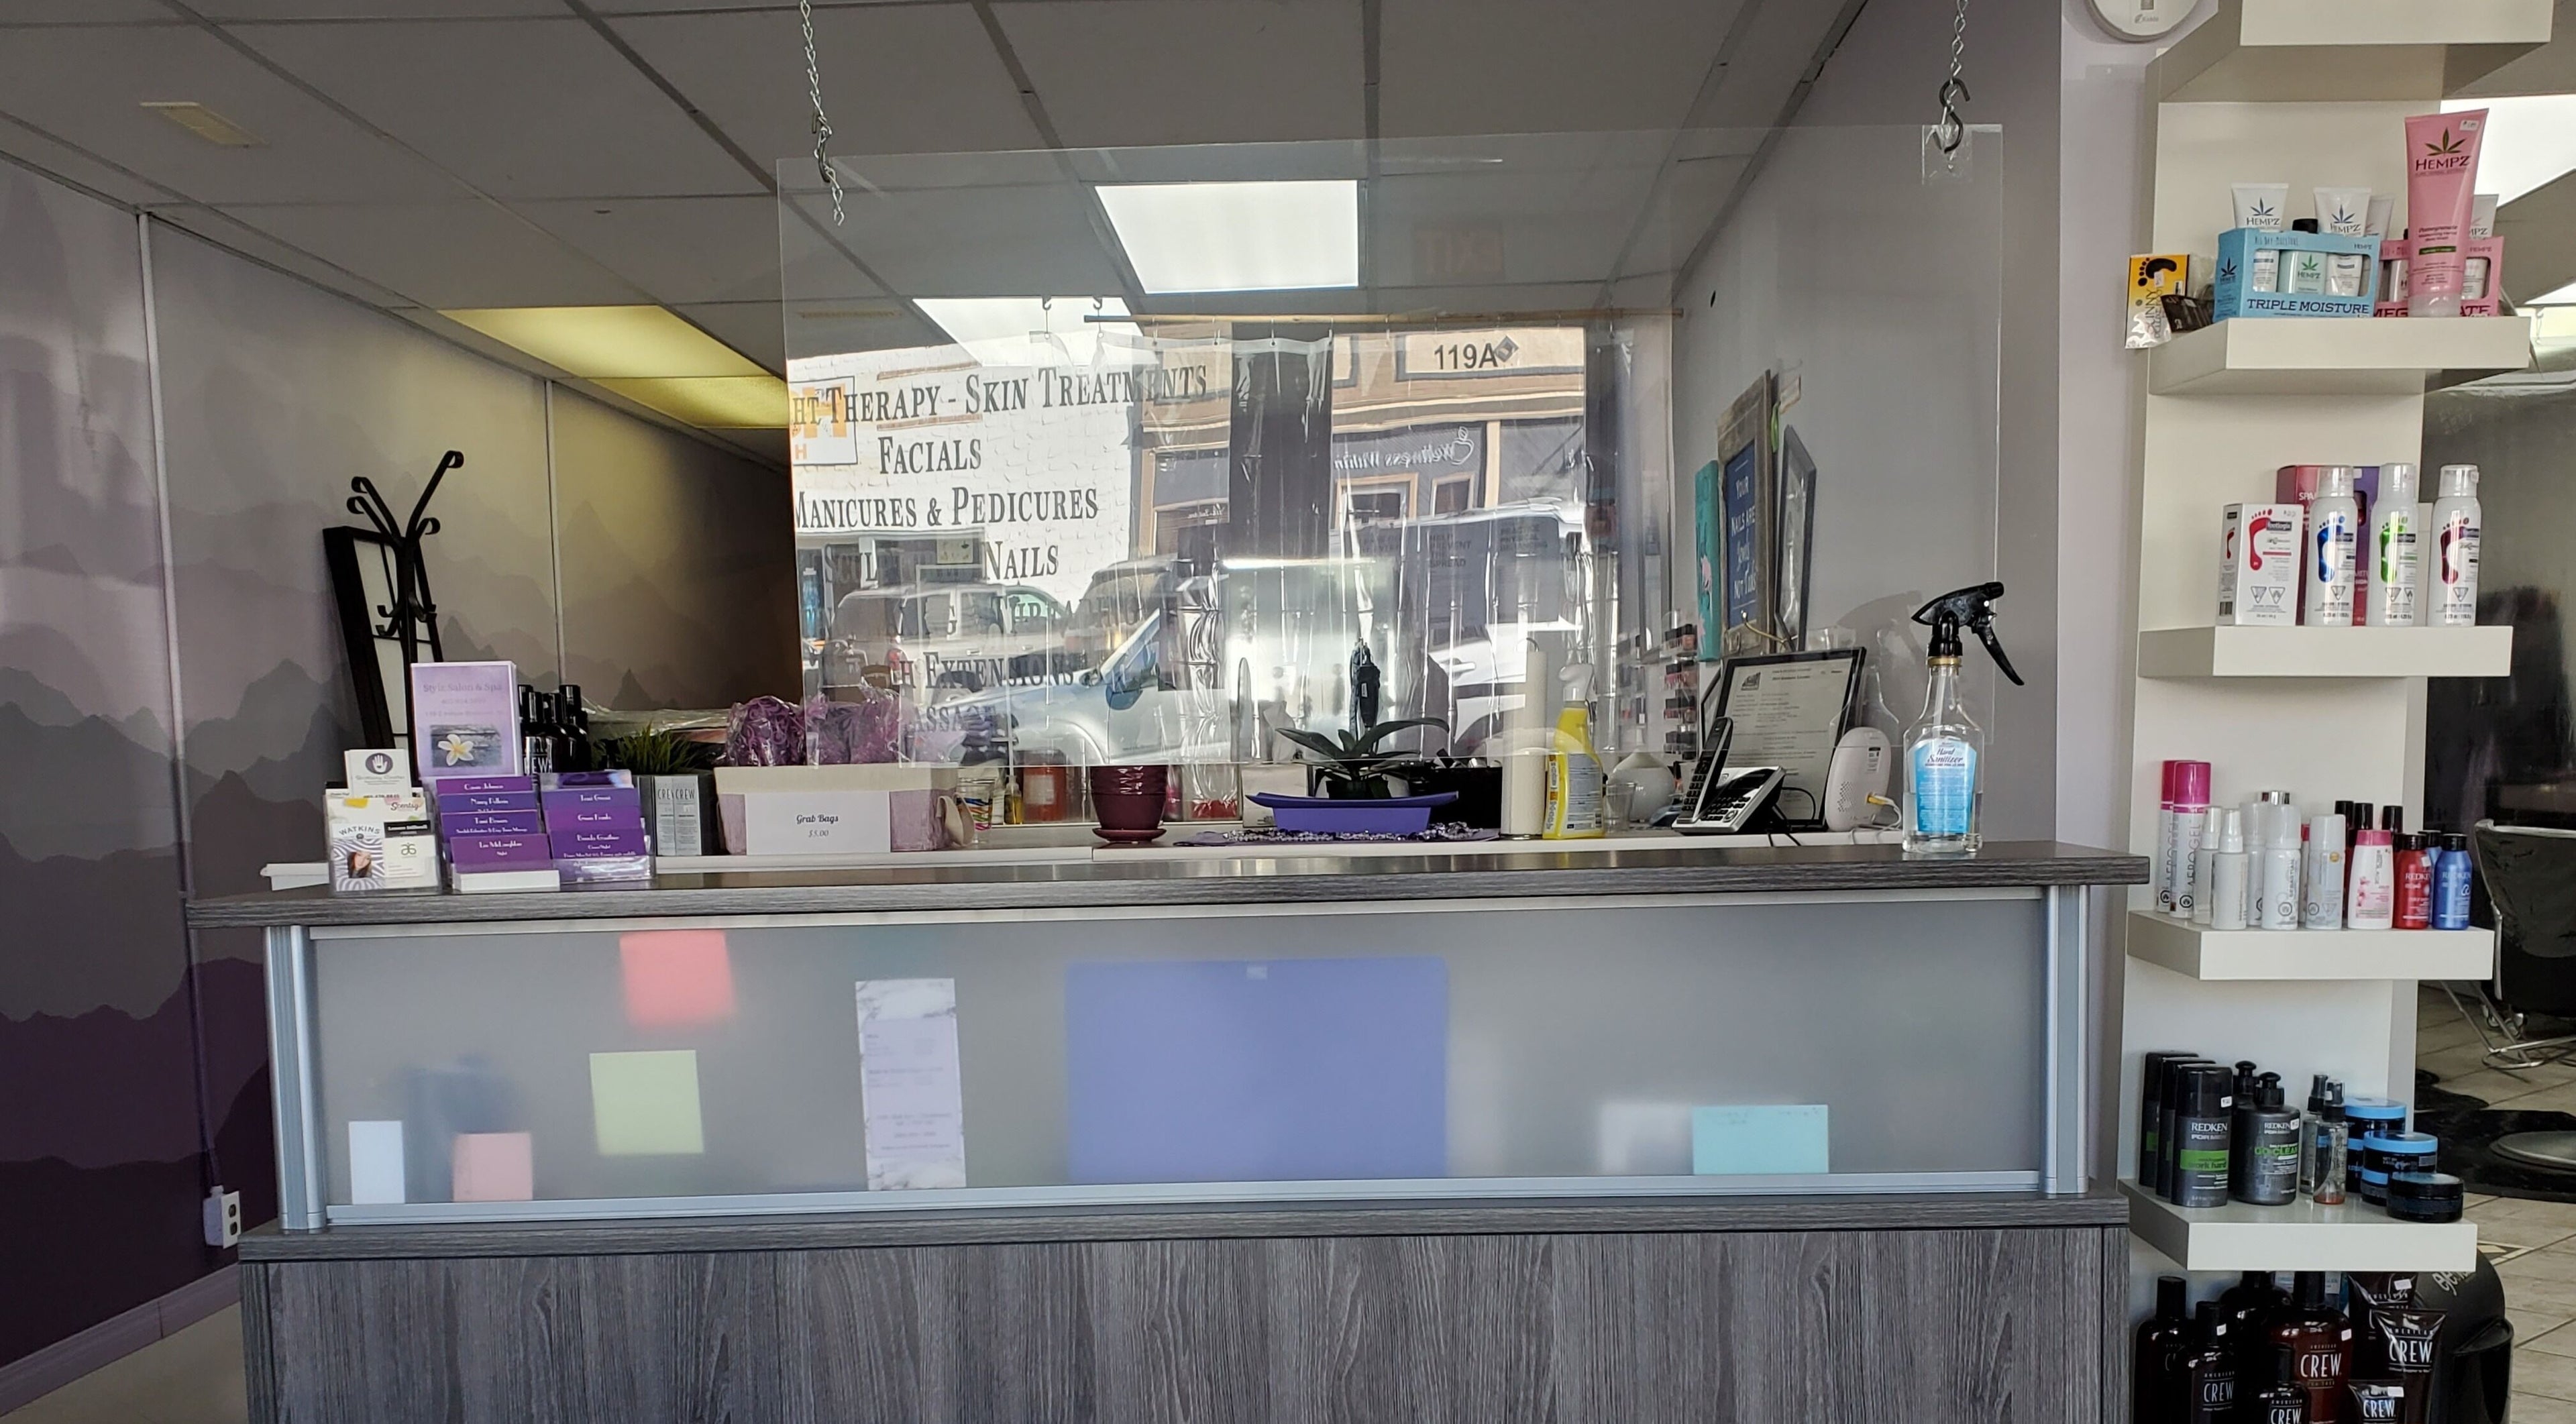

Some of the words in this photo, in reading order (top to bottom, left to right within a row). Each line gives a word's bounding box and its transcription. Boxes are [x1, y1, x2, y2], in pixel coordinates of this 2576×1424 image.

[2416, 156, 2471, 170] HEMPZ
[2247, 217, 2280, 226] HEMPZ
[2330, 223, 2361, 233] HEMPZ
[2298, 271, 2320, 279] HEMPZ
[2247, 299, 2297, 311] TRIPLE
[2299, 301, 2369, 314] MOISTURE
[1434, 342, 1498, 370] 119A
[826, 386, 941, 423] THERAPY
[966, 373, 1028, 414] SKIN
[878, 436, 981, 474] FACIALS
[928, 497, 942, 526] &
[952, 486, 1098, 525] PEDICURES
[982, 541, 1059, 581] NAILS
[447, 683, 474, 692] Salon
[484, 683, 502, 692] Spa
[1927, 754, 1964, 763] Sanitizer
[1936, 748, 1956, 756] Hand
[676, 788, 694, 800] CREW
[796, 814, 816, 824] Grab
[818, 814, 839, 824] Bags
[339, 825, 381, 836] WATKINS
[2192, 1122, 2227, 1132] REDKEN
[2389, 1340, 2432, 1363] CREW
[2300, 1353, 2342, 1378] CREW
[2204, 1380, 2235, 1403] CREW
[2363, 1399, 2396, 1418] CREW
[2271, 1408, 2302, 1424] CREW
